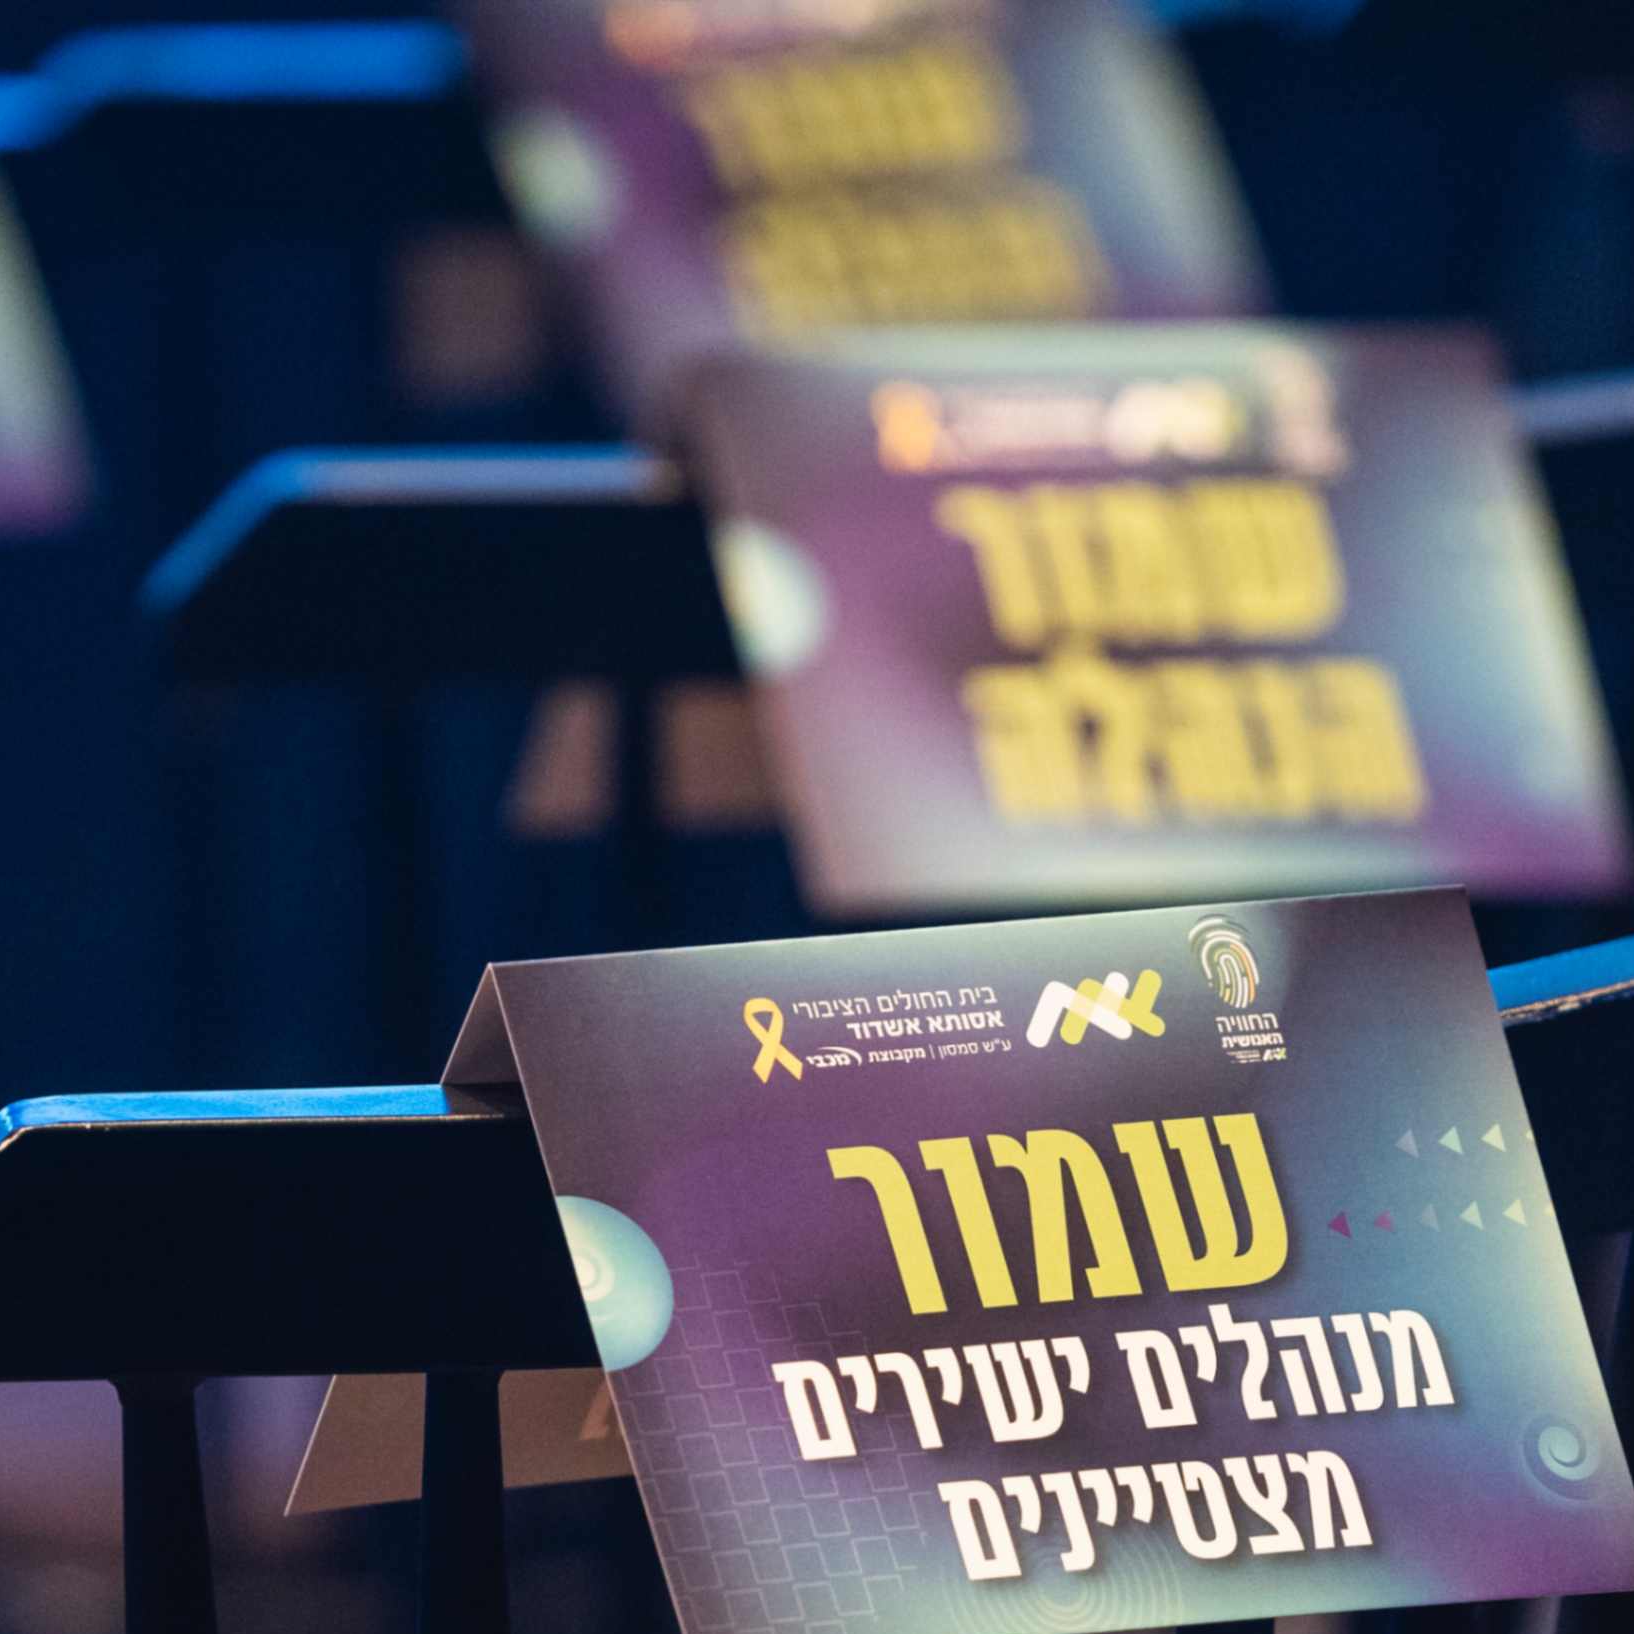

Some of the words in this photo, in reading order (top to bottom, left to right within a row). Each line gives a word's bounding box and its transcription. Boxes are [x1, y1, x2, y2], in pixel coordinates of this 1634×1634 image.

[877, 989, 952, 1014] החולים
[958, 986, 998, 1005] בית
[792, 997, 871, 1020] הציבורי
[846, 1018, 923, 1040] אשדוד
[925, 1010, 1004, 1032] אסותא
[1215, 1012, 1279, 1033] החוויה
[806, 1052, 852, 1068] מכבי
[868, 1046, 926, 1064] מקבוצת
[826, 1113, 1288, 1315] שמור
[1115, 1303, 1454, 1429] מנהלים
[772, 1336, 1090, 1461] ישירים
[937, 1450, 1372, 1581] מצטיינים
